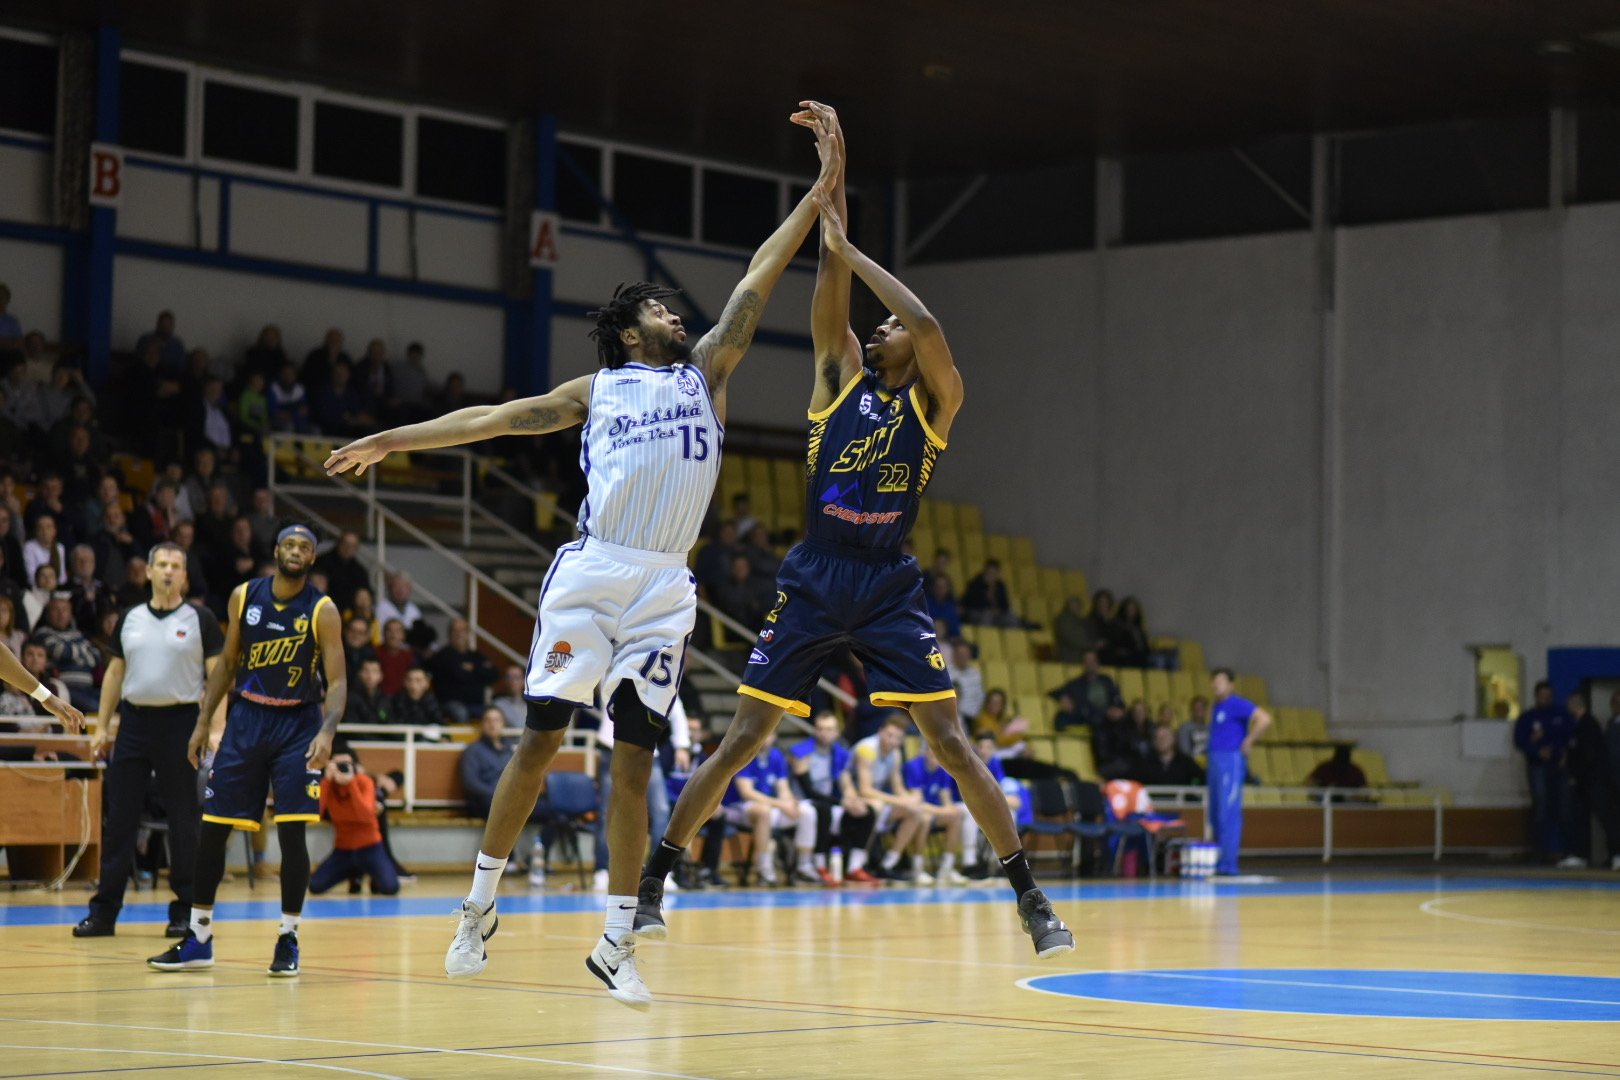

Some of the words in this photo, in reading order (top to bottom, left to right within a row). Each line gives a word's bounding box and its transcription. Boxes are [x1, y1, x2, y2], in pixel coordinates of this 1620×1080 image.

[93, 151, 121, 198] B
[532, 219, 560, 262] A
[676, 424, 709, 463] 15
[877, 463, 909, 492] 22
[287, 666, 303, 687] 7
[544, 651, 574, 669] SNV
[639, 649, 674, 688] 15
